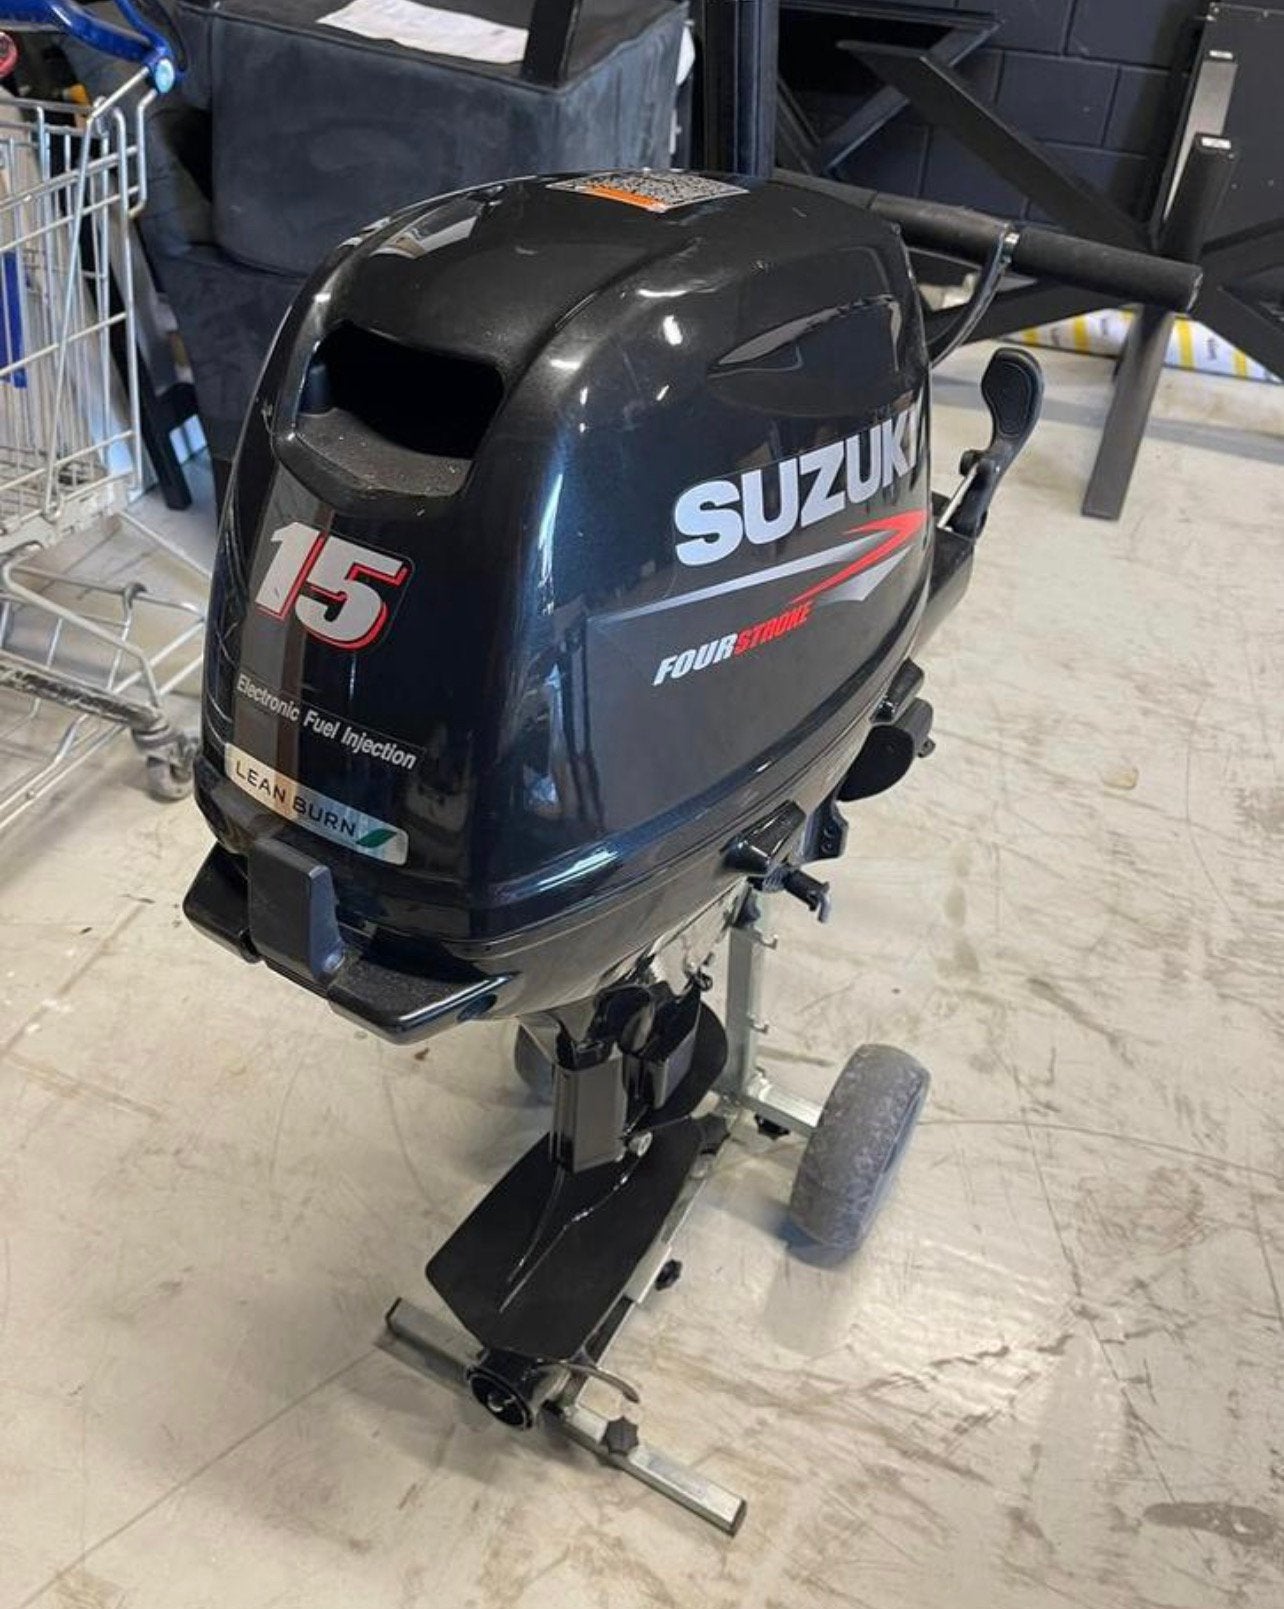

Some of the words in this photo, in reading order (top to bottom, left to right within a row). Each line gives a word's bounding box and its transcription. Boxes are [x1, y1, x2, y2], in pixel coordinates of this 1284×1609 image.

[674, 410, 918, 566] SUZUKI
[254, 521, 411, 651] 15
[237, 673, 300, 722] Electronic
[303, 709, 341, 739] Fuel
[341, 726, 417, 769] Injection
[235, 760, 286, 804] LEAN
[293, 799, 357, 837] BURN
